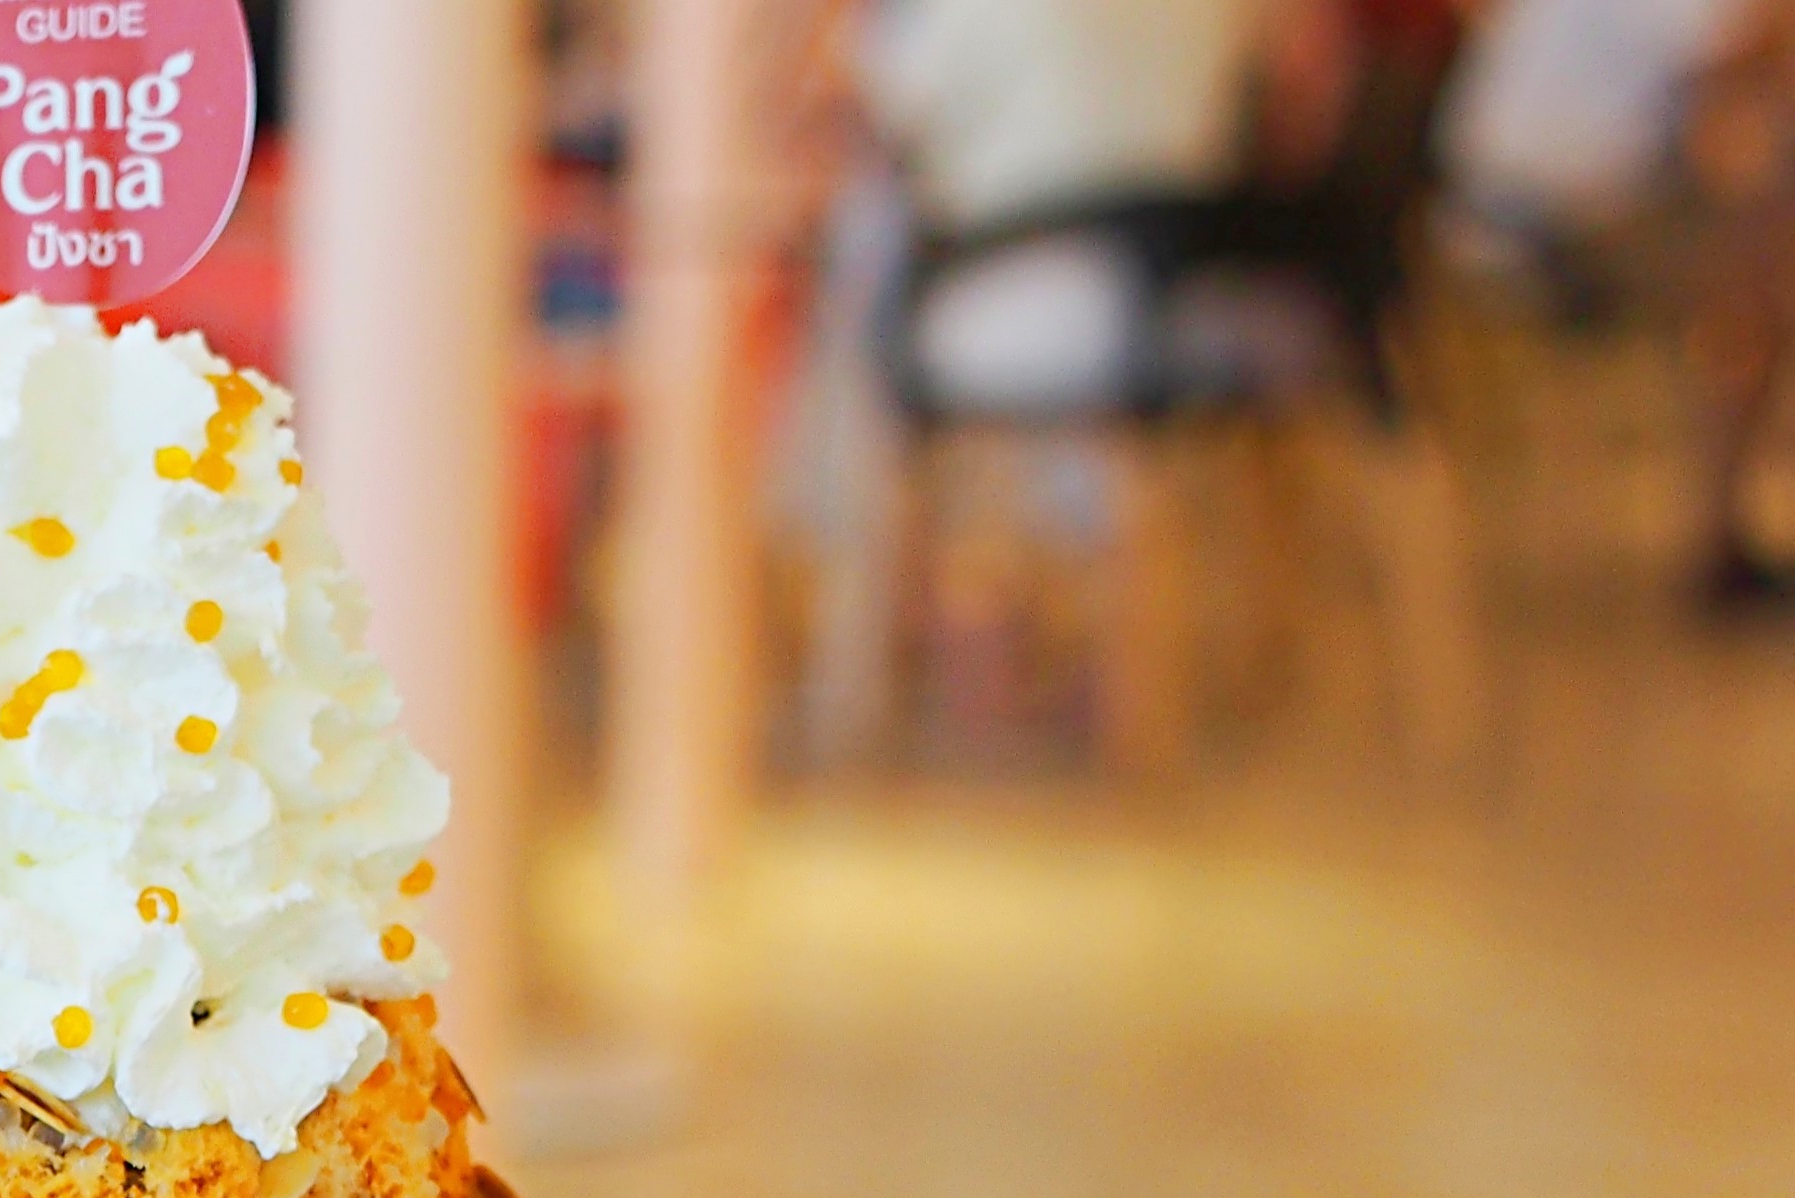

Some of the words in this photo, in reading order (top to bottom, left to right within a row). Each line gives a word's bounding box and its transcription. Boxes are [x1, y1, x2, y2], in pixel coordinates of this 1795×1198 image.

[16, 3, 147, 43] GUIDE
[0, 138, 164, 215] Cha
[27, 221, 144, 270] ปังชา
